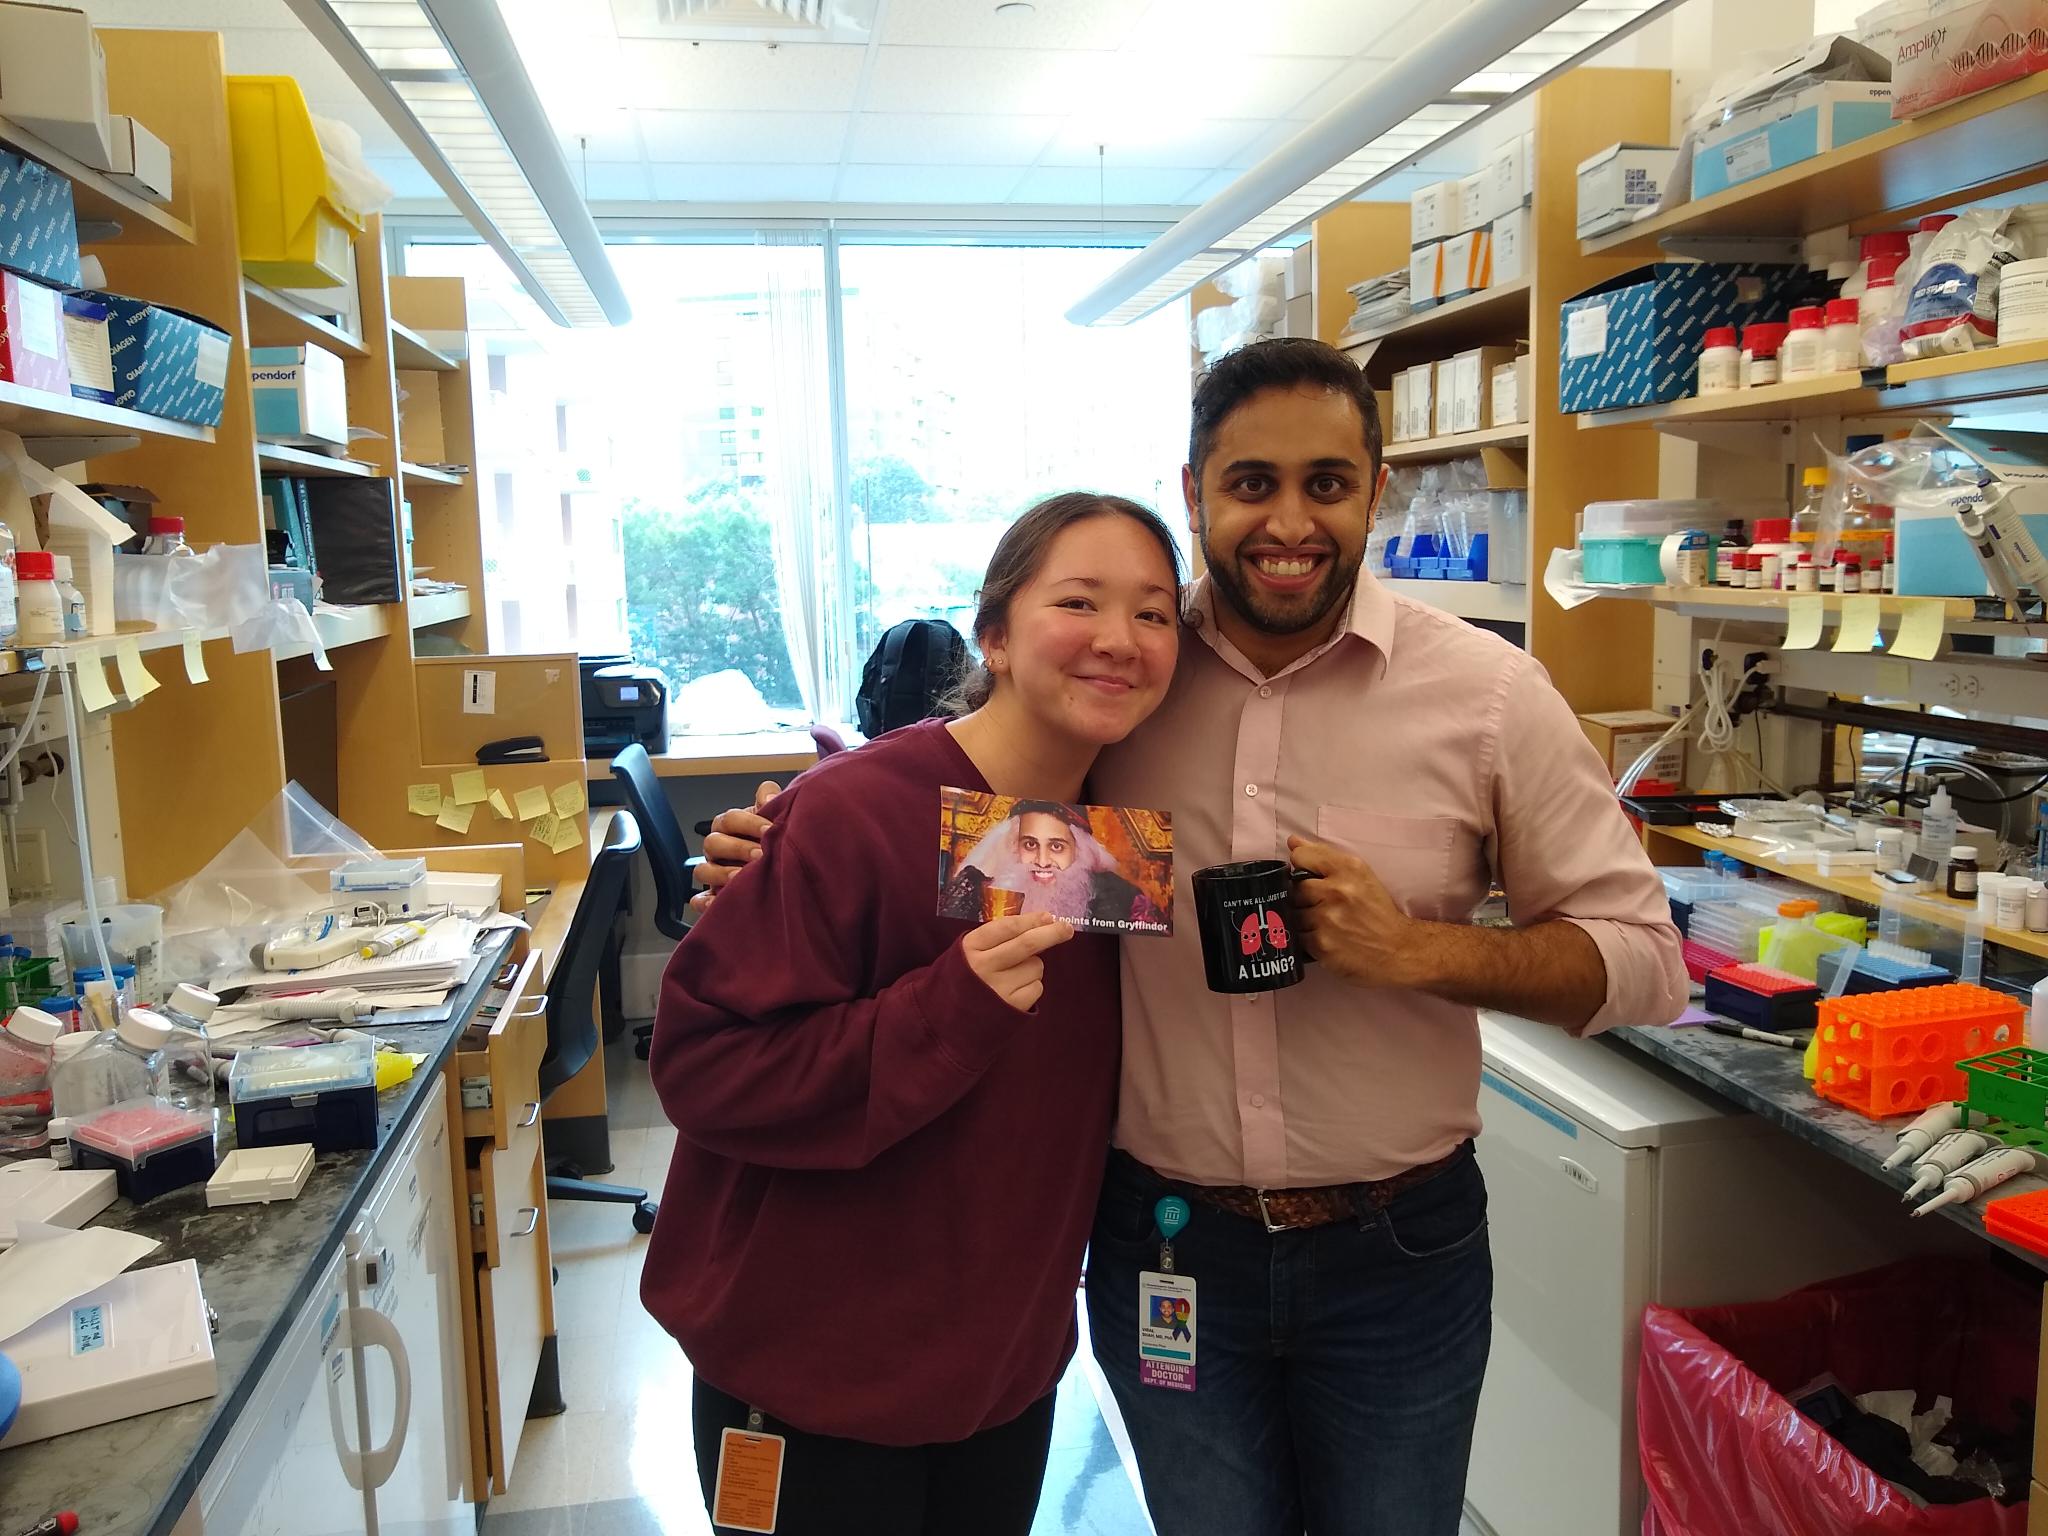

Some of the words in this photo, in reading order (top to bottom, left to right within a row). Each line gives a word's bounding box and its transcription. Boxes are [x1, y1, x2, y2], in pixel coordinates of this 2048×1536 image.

[8, 232, 21, 258] QIAGEN
[1223, 899, 1242, 908] CAN'T
[1243, 898, 1253, 906] WE
[1254, 896, 1266, 905] ALL
[1266, 892, 1280, 902] JUST
[1059, 916, 1090, 926] points
[1092, 917, 1115, 928] from
[1118, 919, 1168, 931] Gryffindor
[1239, 964, 1249, 980] A
[1251, 955, 1295, 978] LUNG?
[1146, 1360, 1190, 1374] ATTENDING
[1151, 1369, 1184, 1382] DOCTOR
